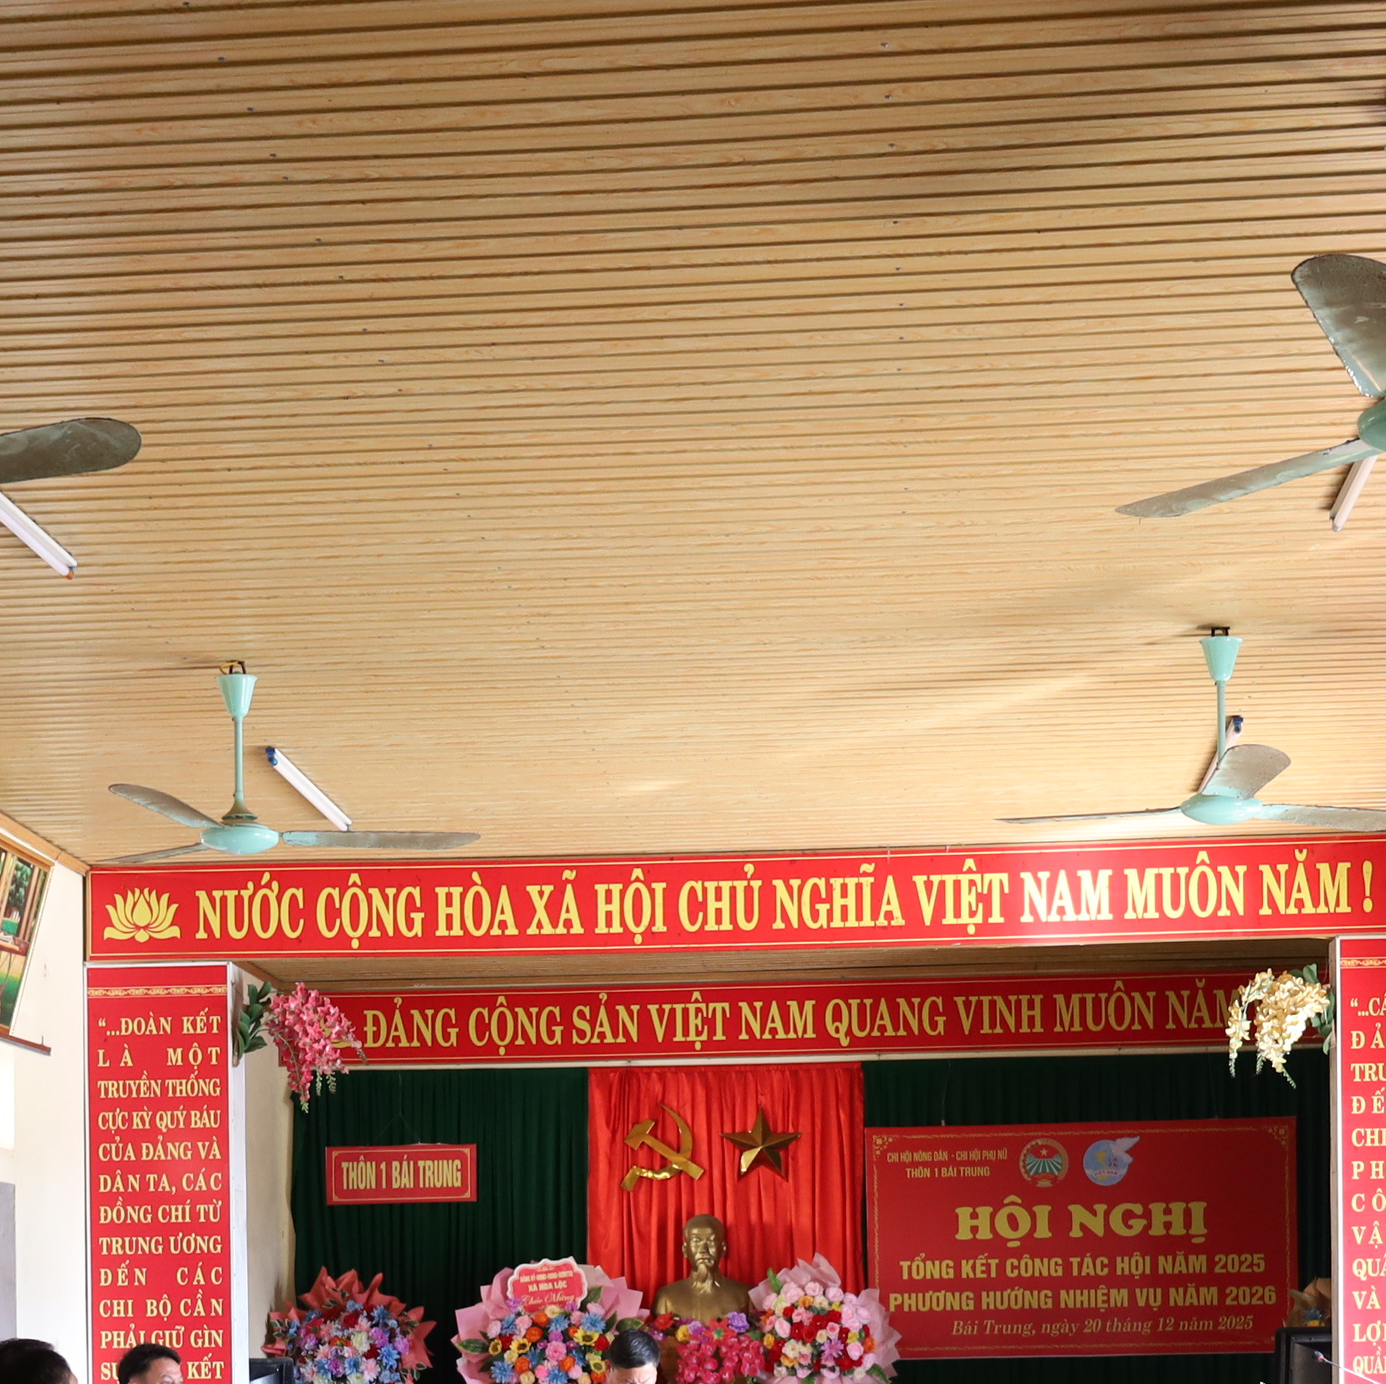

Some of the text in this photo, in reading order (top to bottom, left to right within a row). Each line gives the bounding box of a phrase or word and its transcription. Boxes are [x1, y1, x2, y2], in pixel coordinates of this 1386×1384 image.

[195, 872, 304, 939] NƯỚC
[316, 873, 425, 949] CỘNG
[435, 872, 519, 936] HÒA
[526, 870, 584, 934] XÃ
[594, 868, 667, 944] HỘI
[679, 864, 762, 932] CHỦ
[772, 863, 904, 929] NGHĨA
[913, 858, 1009, 934] VIỆT
[1020, 869, 1113, 922] NAM
[1124, 851, 1247, 919] MUÔN
[1259, 849, 1351, 915] NĂM
[182, 1008, 221, 1034] KẾT
[363, 996, 459, 1048] ĐẢNG
[468, 995, 565, 1056] CỘNG
[571, 991, 644, 1046] SẢN
[648, 992, 730, 1050] VIỆT
[738, 1000, 815, 1040] NAM
[824, 997, 947, 1046] QUANG
[953, 994, 1045, 1035] VINH
[1053, 981, 1154, 1033] MUÔN
[98, 1043, 220, 1069] LÀ MỘT
[98, 1071, 221, 1098] TRUYỀN THỐNG
[98, 1105, 221, 1133] CỰC KỲ QUÝ BÁU
[99, 1135, 221, 1161] CỦA ĐẢNG VÀ
[99, 1168, 222, 1194] DÂN TA, CÁC
[341, 1155, 461, 1189] THÔN 1 BÁI TRUNG
[906, 1165, 990, 1178] THÔN 1 BÁI TRUNG
[99, 1197, 222, 1224] ĐỒNG CHÍ TỪ
[955, 1195, 1208, 1247] HỘI NGHỊ
[99, 1232, 222, 1255] TRUNG ƯƠNG
[100, 1260, 222, 1286] ĐẾN CÁC
[900, 1251, 1265, 1280] TỔNG KẾT CÔNG TÁC HỘI NĂM 2025
[99, 1289, 223, 1321] CHI BỘ CẦN
[887, 1283, 1276, 1315] PHƯƠNG HƯỚNG NHIỆM VỤ NĂM 2026
[1352, 1285, 1381, 1310] VÀ
[101, 1323, 223, 1348] PHẢI GIỮ GÌN
[952, 1315, 1253, 1337] Bái Trung, ngày 20 tháng 12 năm 2025
[187, 1353, 224, 1379] KẾT
